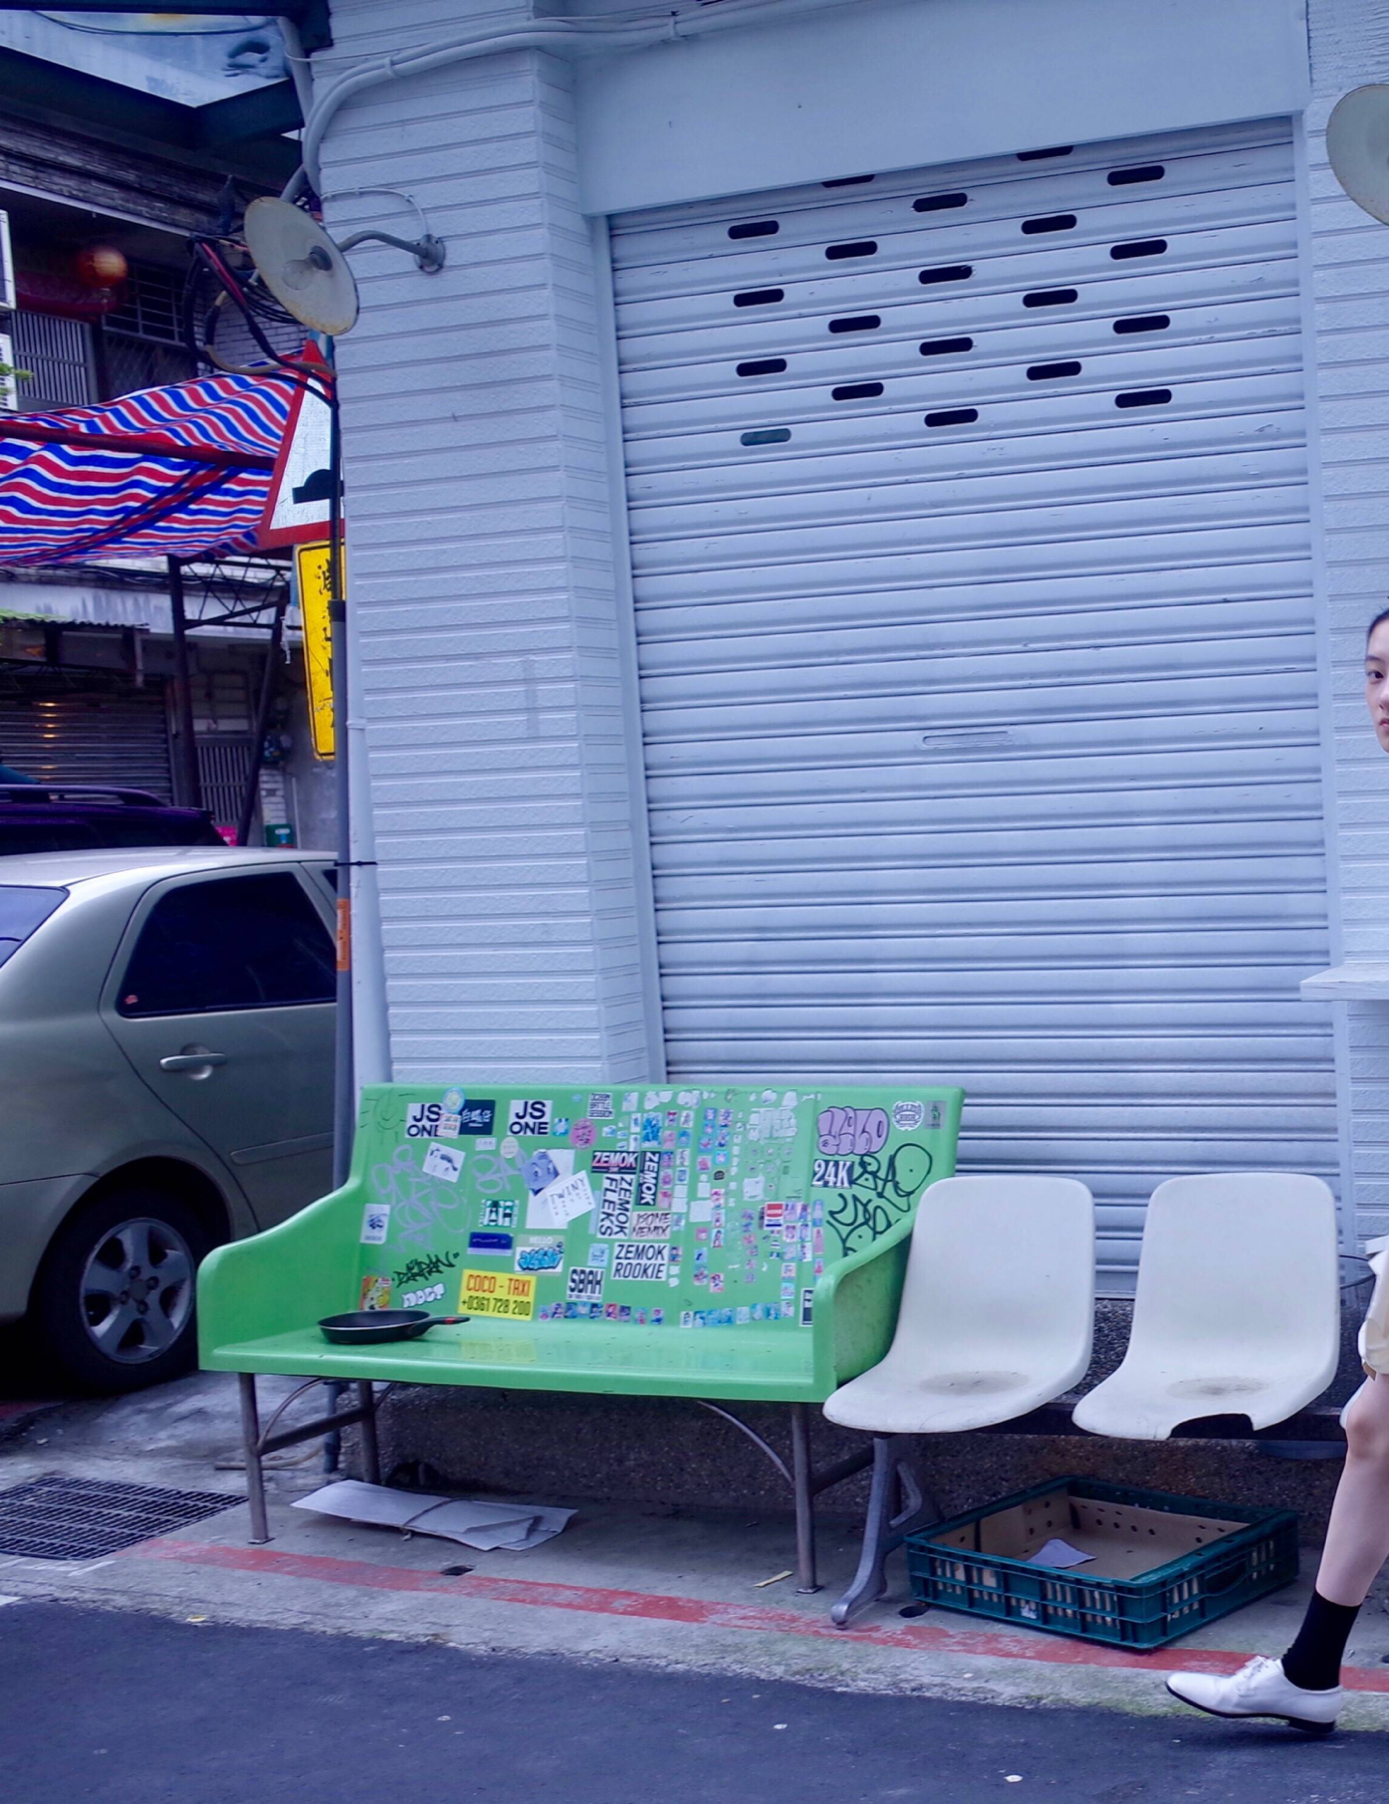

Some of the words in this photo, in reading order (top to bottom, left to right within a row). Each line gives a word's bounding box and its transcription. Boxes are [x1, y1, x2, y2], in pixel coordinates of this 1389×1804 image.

[412, 1103, 443, 1123] JS
[515, 1100, 547, 1120] JS
[508, 1121, 550, 1136] ONE
[592, 1151, 639, 1168] ZEMOK
[640, 1151, 660, 1206] ZEMOK
[811, 1159, 852, 1189] 24K
[598, 1175, 618, 1238] FLEKS
[614, 1175, 634, 1237] ZEMOK
[614, 1243, 668, 1261] ZEMOK
[612, 1262, 666, 1280] ROOKIE
[465, 1274, 497, 1294] COCO
[506, 1277, 532, 1298] TAXI
[492, 1296, 510, 1315] 728
[511, 1300, 532, 1317] 200
